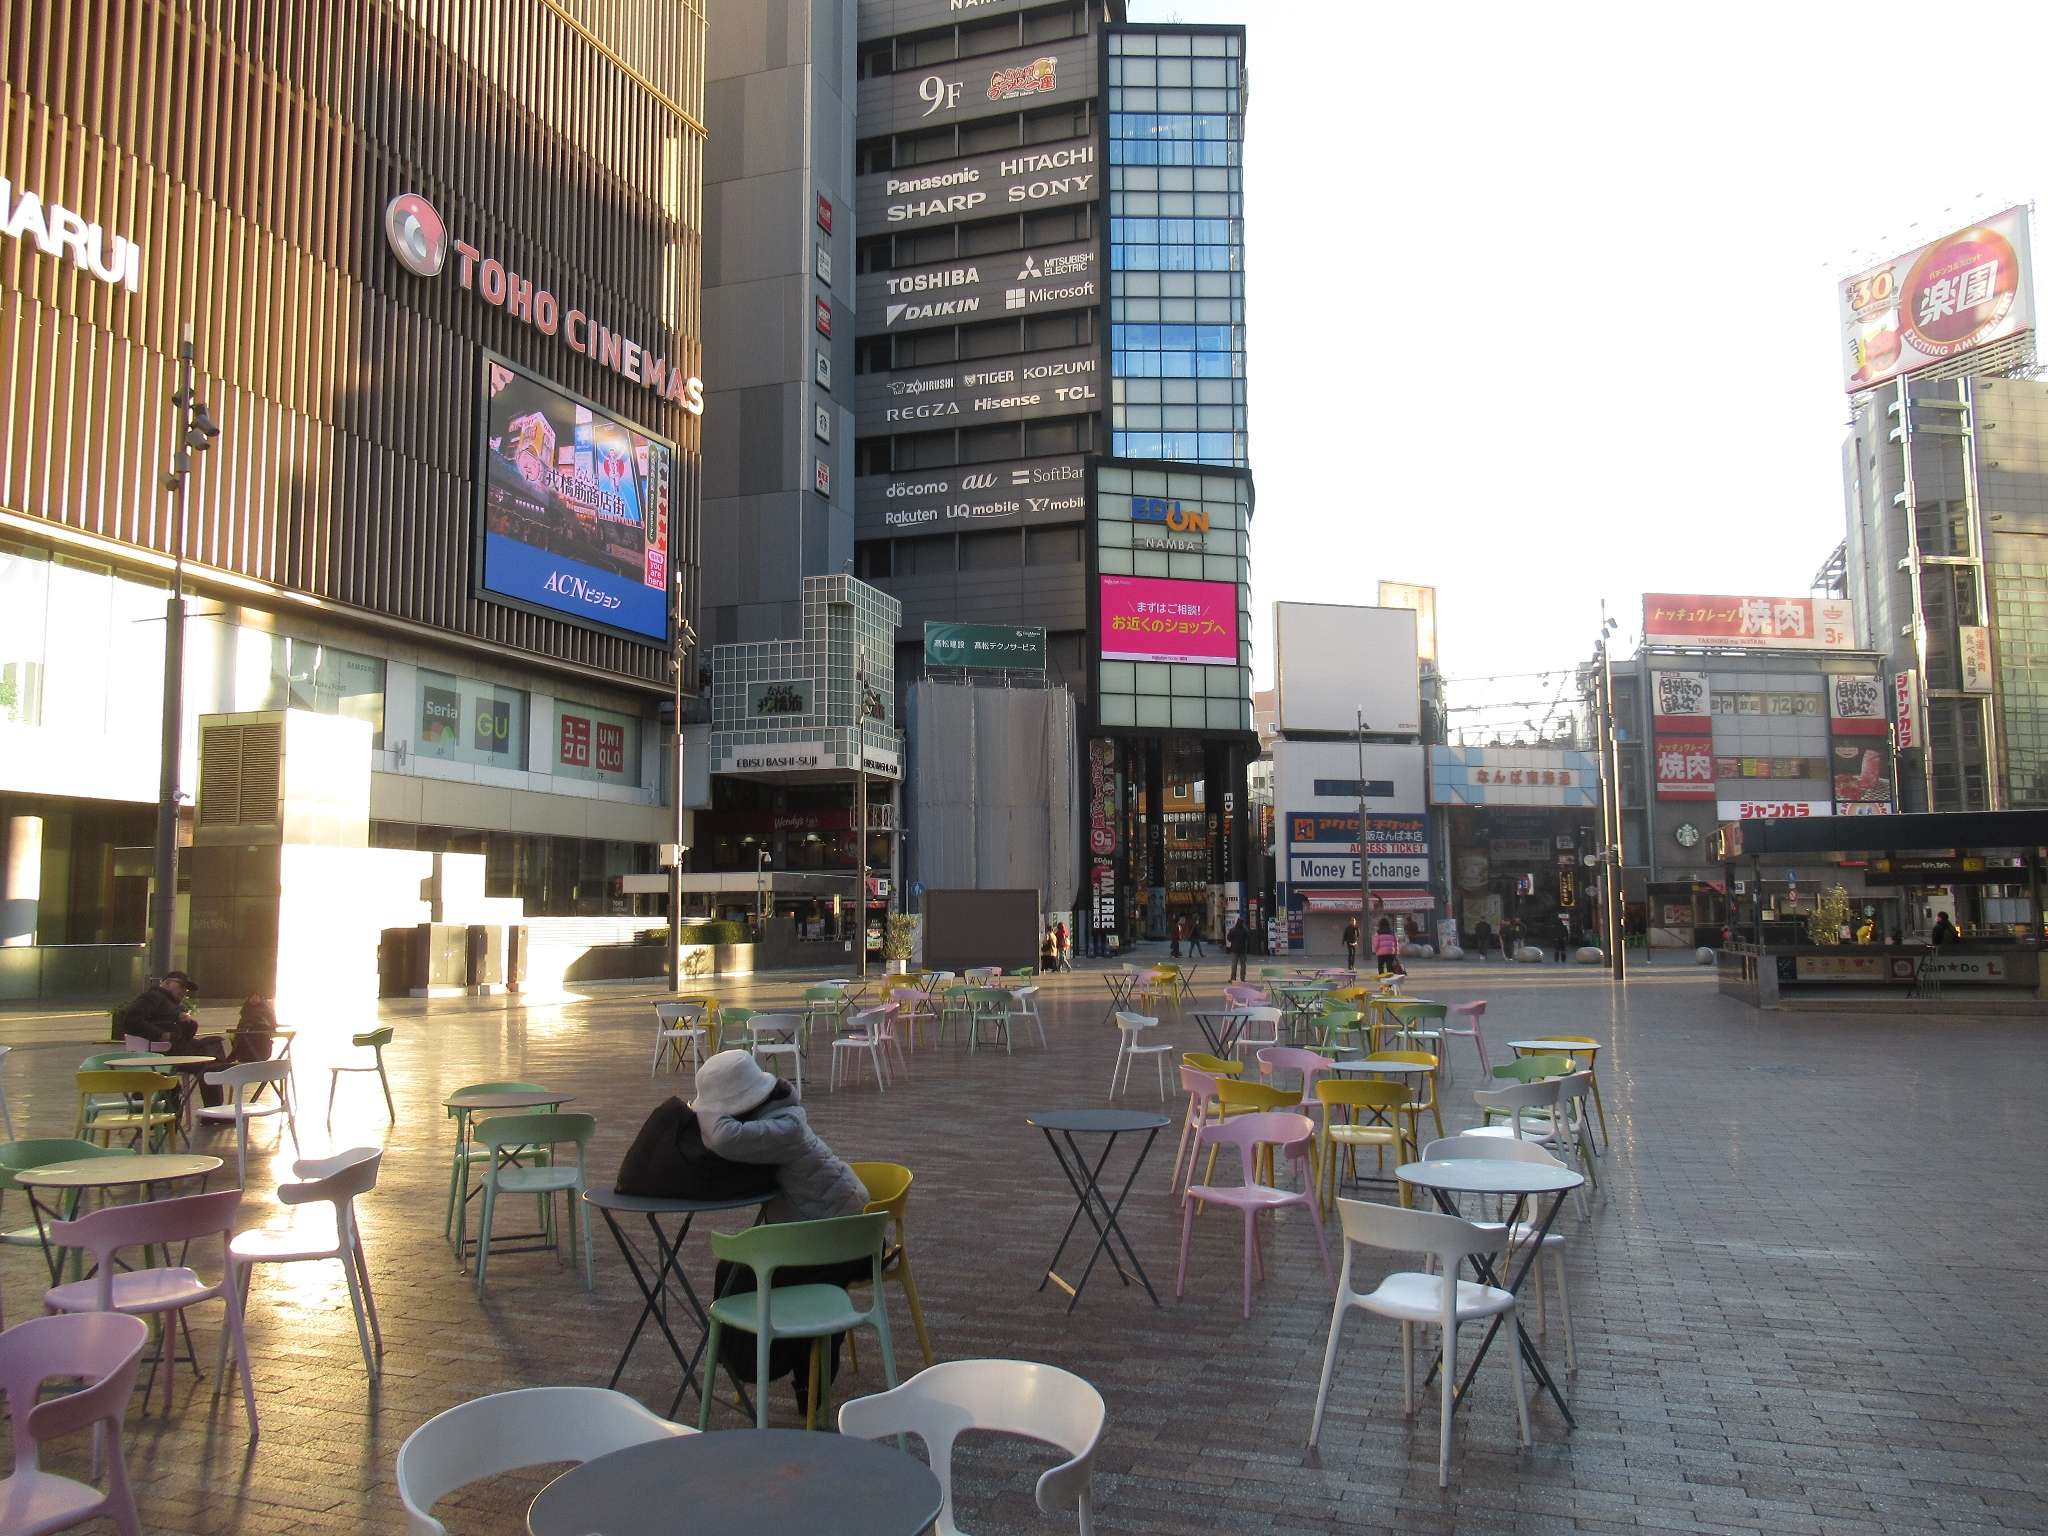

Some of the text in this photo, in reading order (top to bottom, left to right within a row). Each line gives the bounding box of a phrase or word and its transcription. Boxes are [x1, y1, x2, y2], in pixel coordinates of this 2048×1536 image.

[918, 76, 964, 117] 9F
[887, 147, 1093, 195] Panasonic HITACHI
[887, 174, 1093, 222] SHARP SONY
[0, 176, 140, 293] ARUI
[1044, 252, 1094, 268] MITSUBISHI
[1044, 261, 1087, 276] ELECTRIC
[887, 267, 980, 295] TOSHIBA
[1029, 282, 1094, 303] Microsoft
[1919, 260, 1998, 327] 楽園
[905, 297, 979, 321] DAIKIN
[453, 239, 704, 416] TOHO CINEMAS
[1904, 328, 1949, 356] EXCITING
[906, 360, 1095, 396] ZOJIRUSHI TIGER KOIZUMI
[886, 385, 1095, 422] REGZA Hisense TCL
[547, 469, 625, 518] 戎橋筋商店街
[886, 466, 1084, 498] docomo au SoftBan
[886, 498, 1085, 525] Rakuten UQ mobile Y!mobil
[1131, 496, 1210, 533] EDION
[1145, 538, 1195, 551] NAMBA
[650, 561, 662, 571] you
[650, 570, 662, 579] are
[648, 575, 664, 587] here
[1137, 602, 1201, 616] まずはご相談!
[1738, 599, 1805, 637] 焼肉
[1112, 615, 1226, 635] お近くのショップへ
[1825, 628, 1843, 645] 3F
[425, 701, 457, 718] Seria
[1896, 673, 1912, 747] ジャンカラ
[477, 713, 509, 739] GU
[565, 721, 587, 741] ユニ
[599, 728, 619, 747] UNI
[564, 741, 586, 761] クロ
[599, 748, 620, 767] QLO
[1659, 751, 1712, 780] 焼肉
[1740, 802, 1810, 818] ジャンカラ
[1391, 843, 1424, 853] TICKET
[1300, 860, 1346, 878] Money
[1101, 869, 1115, 929] TAX FREE
